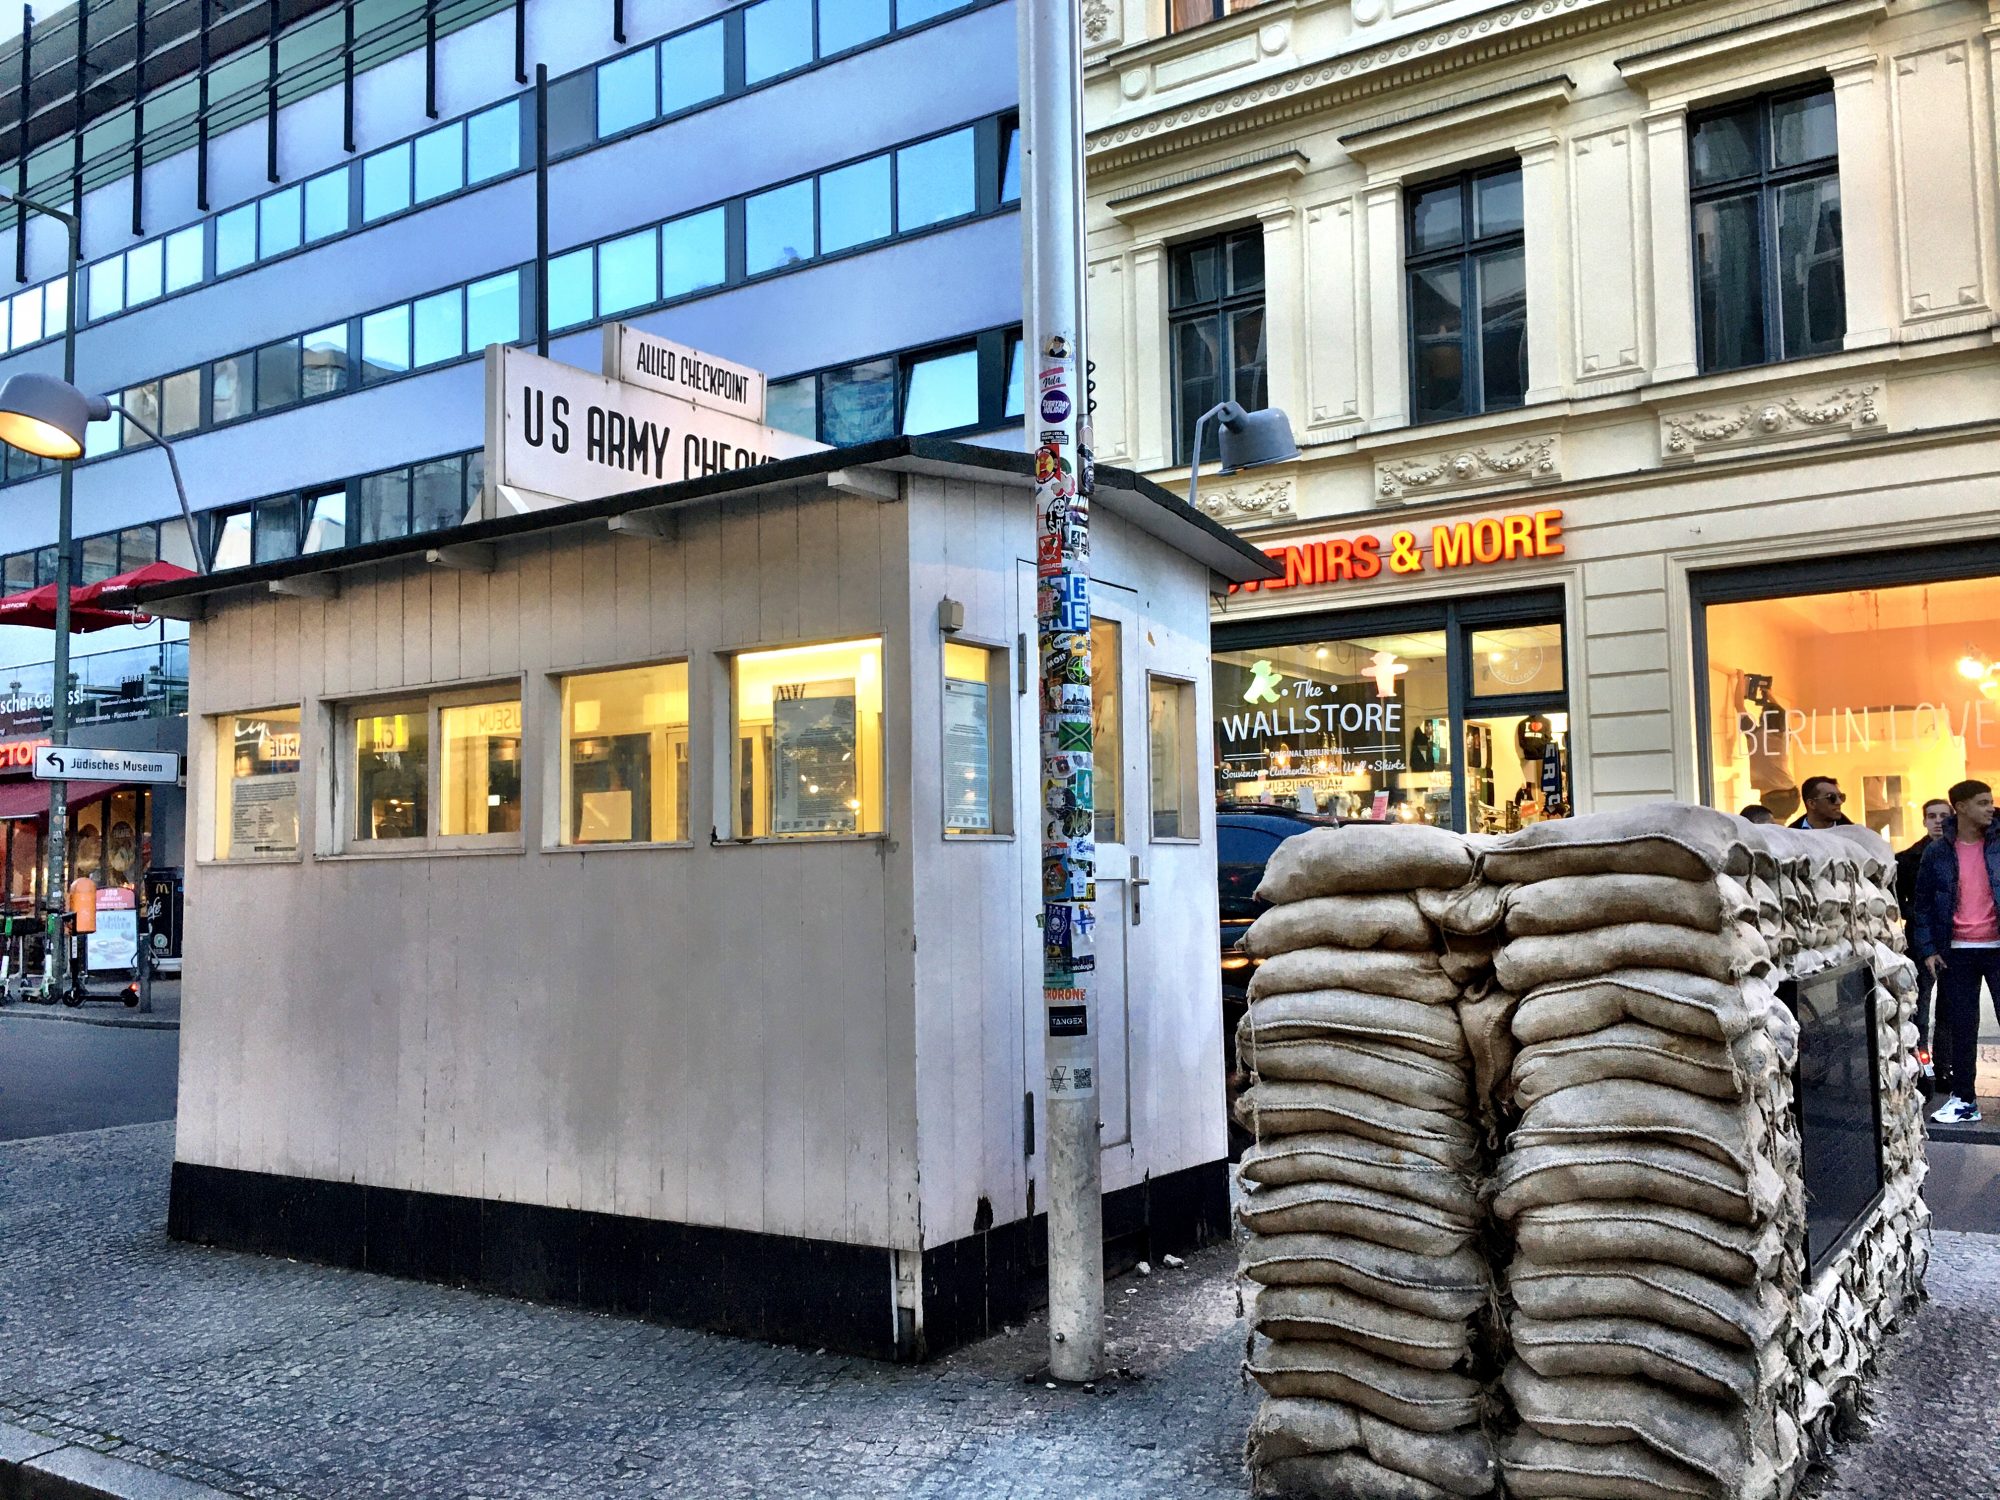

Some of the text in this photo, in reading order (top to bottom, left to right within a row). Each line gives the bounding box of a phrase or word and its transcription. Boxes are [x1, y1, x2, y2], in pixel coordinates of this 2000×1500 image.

[637, 342, 749, 404] ALLIED CHECKPOINT
[524, 386, 570, 454] US
[588, 405, 670, 479] ARMY
[1228, 509, 1566, 595] ENIRS & MORE
[34, 684, 84, 710] Gess!
[1293, 679, 1323, 699] The
[1222, 703, 1401, 742] WALLSTORE
[1735, 700, 1997, 757] BERLIN LOVE
[71, 757, 163, 773] Jüdisches Museum
[1269, 747, 1351, 759] ORIGINAL BERLIN WALL
[1270, 765, 1310, 777] Authentic
[1312, 764, 1339, 775] Berlin
[1374, 759, 1406, 771] Shirts
